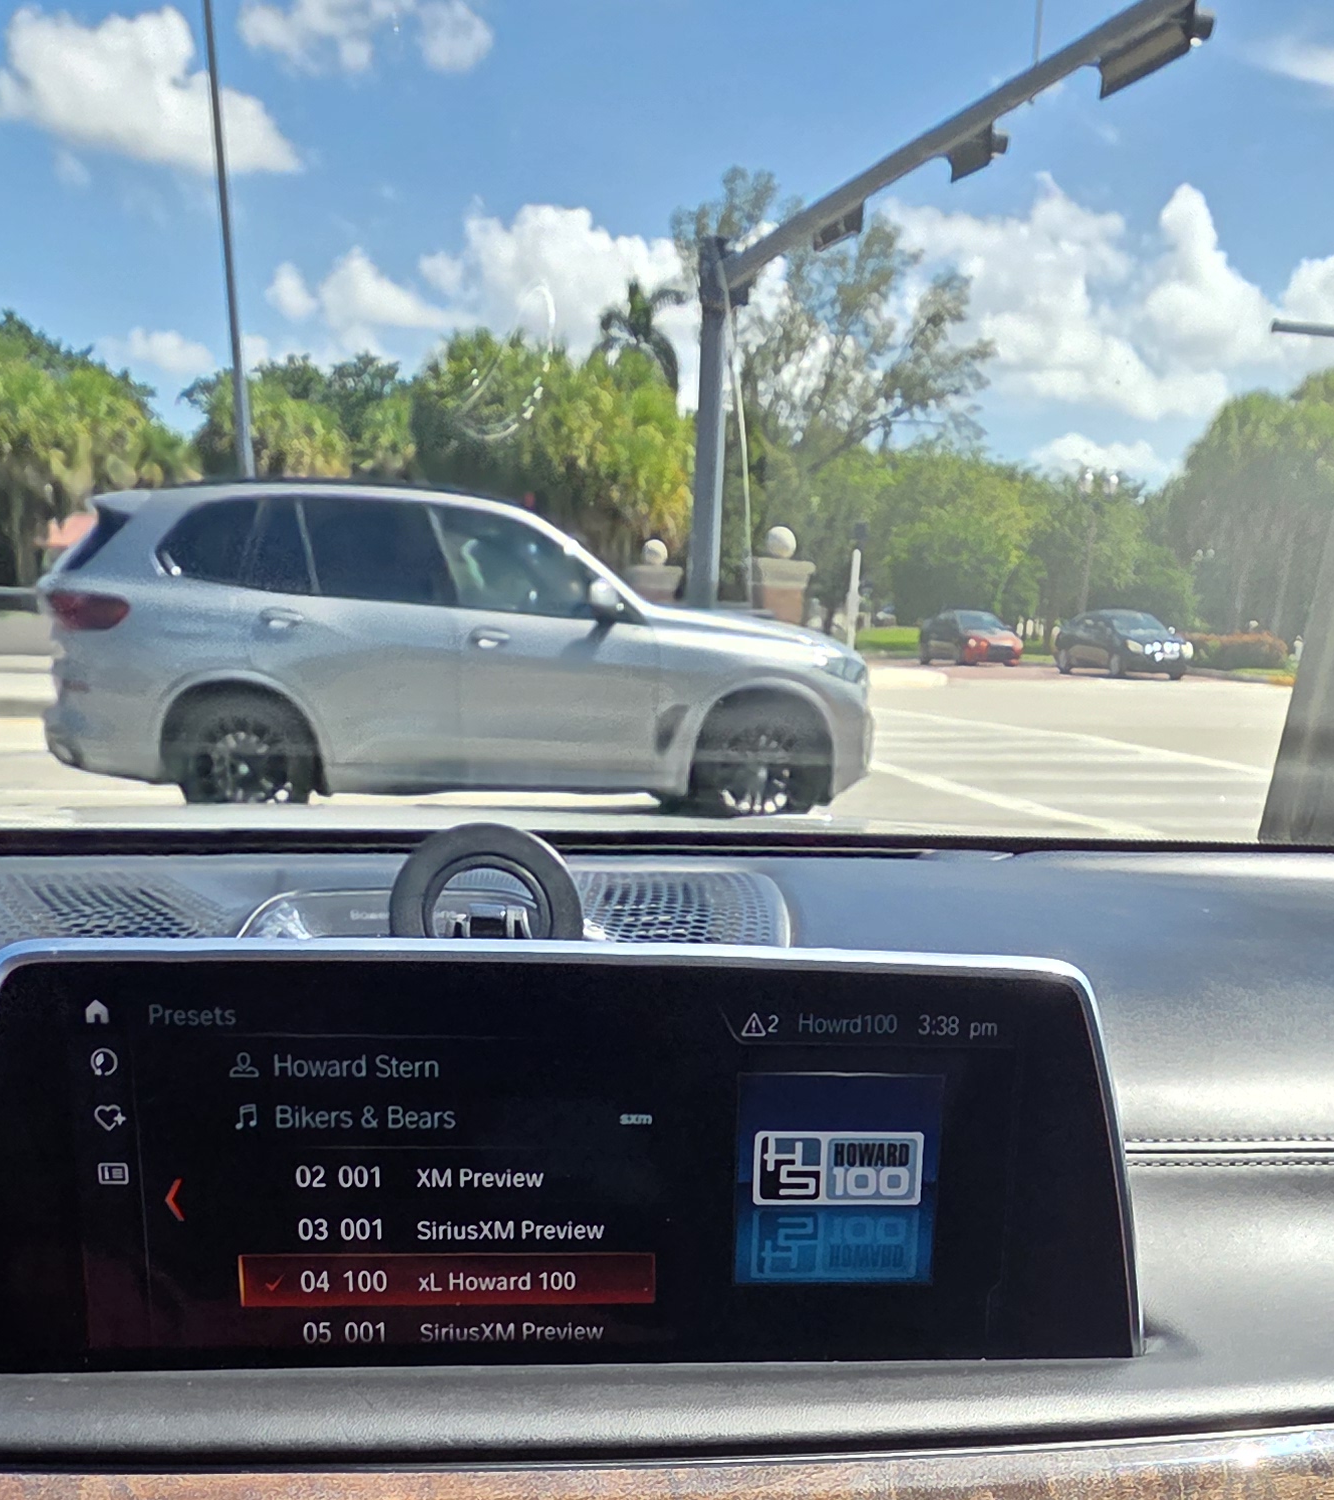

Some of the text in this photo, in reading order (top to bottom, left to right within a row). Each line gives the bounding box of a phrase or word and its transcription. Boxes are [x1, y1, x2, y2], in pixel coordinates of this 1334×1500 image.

[148, 1004, 237, 1025] Presets
[768, 1015, 779, 1033] 2
[918, 1015, 998, 1040] 3:38 pm
[274, 1054, 440, 1078] Howard Stern
[275, 1105, 456, 1129] Bikers & Bears
[834, 1142, 910, 1167] HOWARD
[295, 1165, 545, 1188] 02 001 XM Preview
[832, 1167, 910, 1197] 100
[298, 1218, 605, 1241] 03 001 SiriusXM Preview
[300, 1270, 577, 1293] 04 100 xL Howard 100
[302, 1321, 605, 1344] 05 001 SiriusXM Preview
